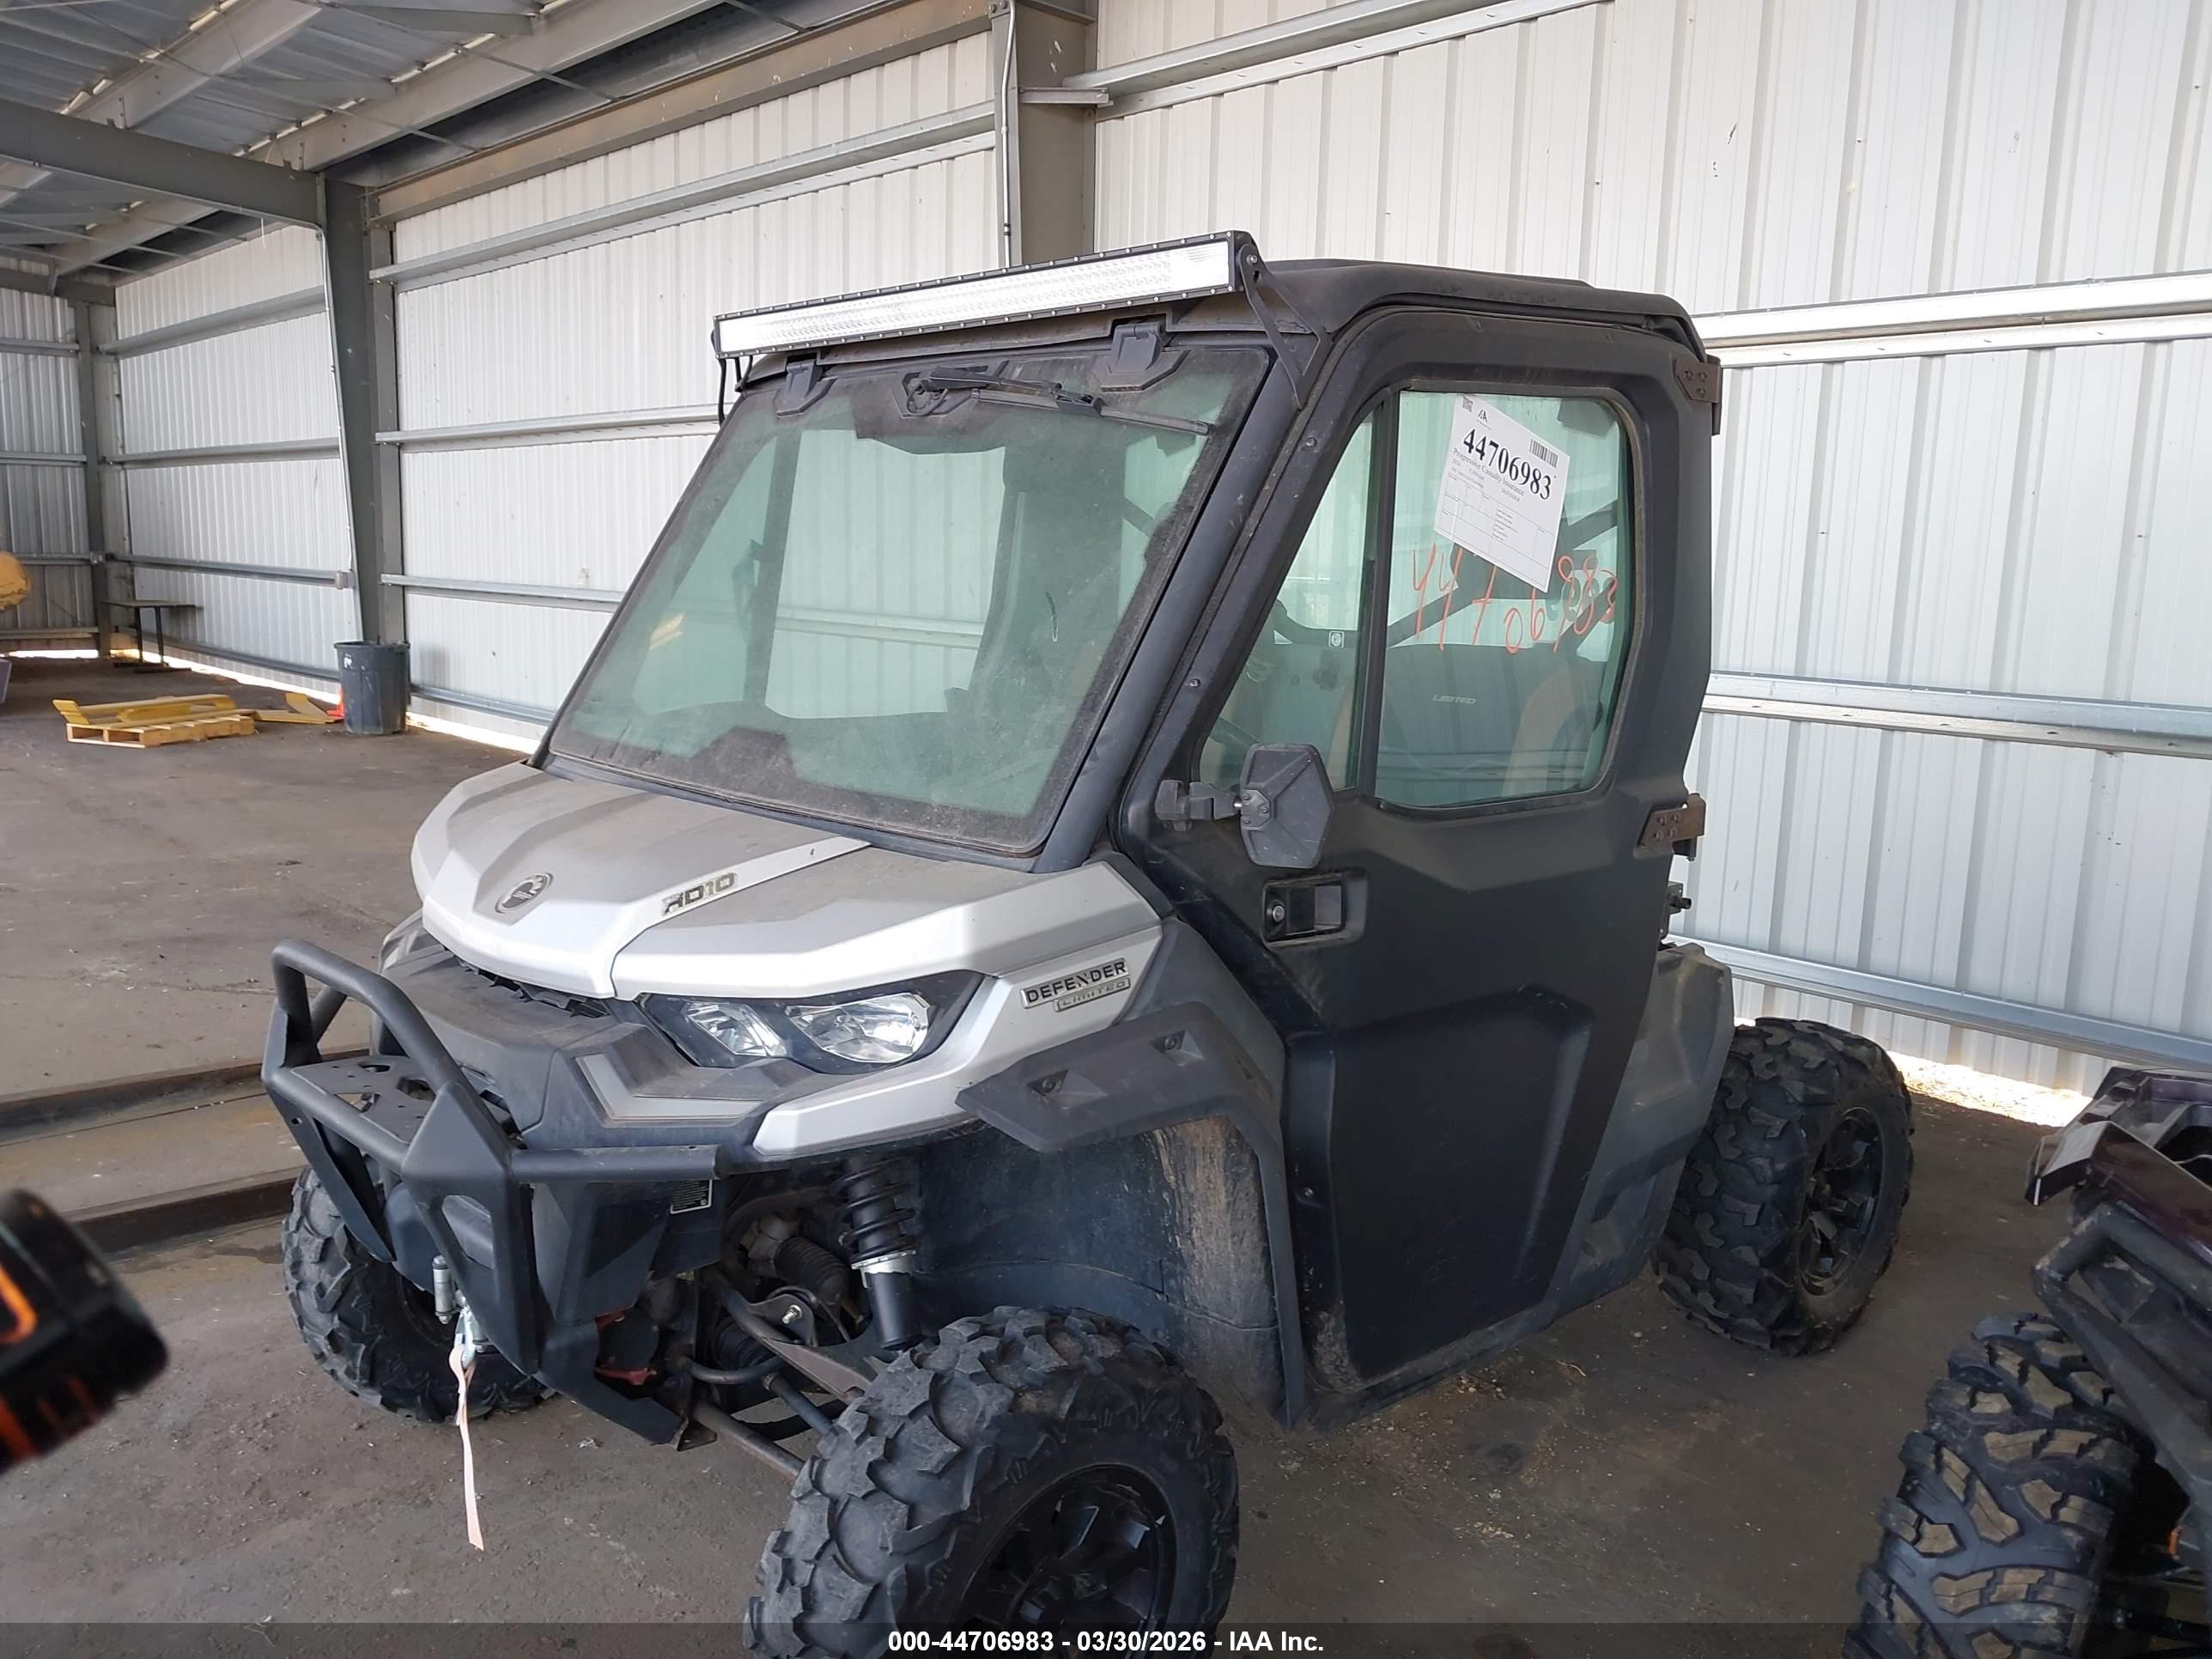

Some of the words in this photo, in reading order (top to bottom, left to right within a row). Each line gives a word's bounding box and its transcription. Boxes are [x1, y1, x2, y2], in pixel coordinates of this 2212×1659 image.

[1463, 428, 1551, 500] 44706983
[1027, 961, 1127, 1003] DEFENDER
[1063, 981, 1126, 1006] LIMITED
